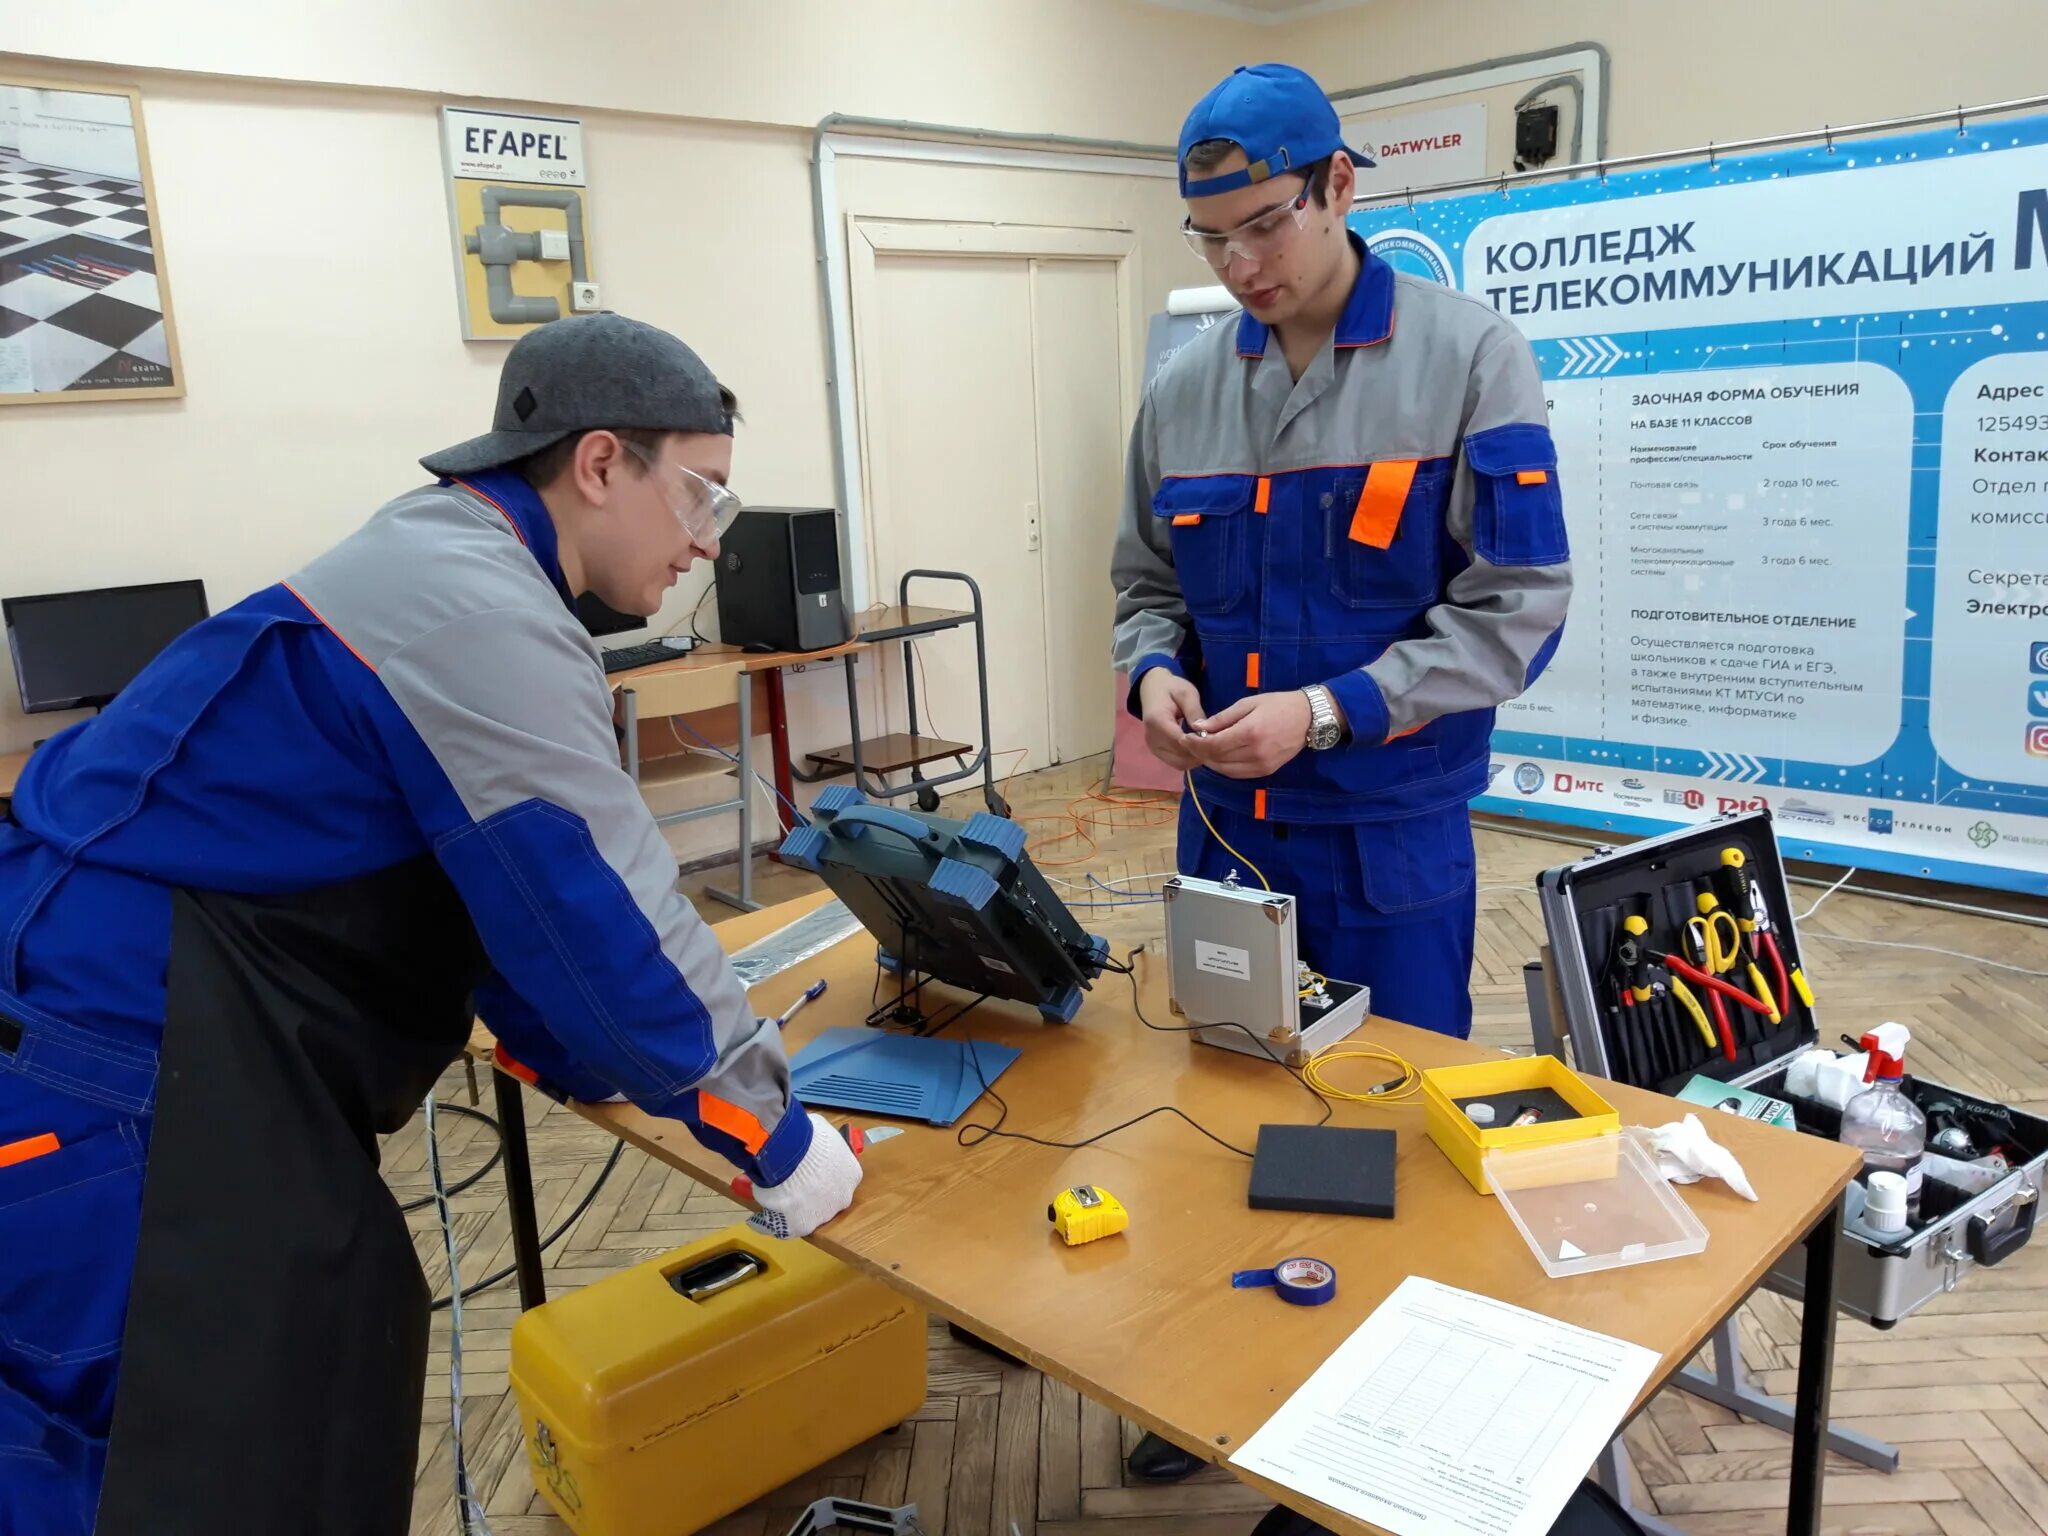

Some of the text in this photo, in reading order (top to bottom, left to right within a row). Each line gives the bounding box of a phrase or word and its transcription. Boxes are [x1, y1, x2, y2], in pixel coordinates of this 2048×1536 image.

[466, 127, 567, 160] EFAPEL
[1486, 222, 1696, 275] КОЛЛЕДЖ
[1486, 231, 1995, 315] ТЕЛЕКОММУНИКАЦИЙ
[1632, 383, 1859, 406] ЗАОЧНАЯ ФОРМА ОБУЧЕНИЯ
[1977, 384, 2044, 401] Адрес
[1631, 415, 1752, 430] НА БАЗЕ 11 КЛАССОВ
[1630, 444, 1697, 453] Наименование
[1762, 440, 1837, 450] Срок обучения
[1630, 454, 1753, 464] профессии/специальности
[1763, 478, 1770, 488] 2
[1773, 480, 1798, 489] года
[1801, 478, 1813, 488] 10
[1972, 478, 2036, 494] Отдел
[1762, 517, 1769, 527] 3
[1772, 519, 1797, 527] года
[1799, 517, 1807, 527] 6
[1971, 512, 2048, 524] комисс
[1761, 555, 1769, 565] 3
[1771, 557, 1796, 566] года
[1798, 555, 1806, 566] 6
[1631, 609, 1857, 629] ПОДГОТОВИТЕЛЬНОЕ ОТДЕЛЕНИЕ
[1630, 635, 1814, 656] Осуществляется подготовка
[1630, 653, 1706, 666] школьников
[1721, 658, 1759, 668] сдаче
[1762, 659, 1790, 670] ГИА
[1631, 668, 1863, 692] а также внутренним вступительным
[1631, 684, 1804, 704] испытаниями КТ МТУСИ по
[1709, 704, 1797, 720] информатике
[1575, 780, 1604, 793] МТС
